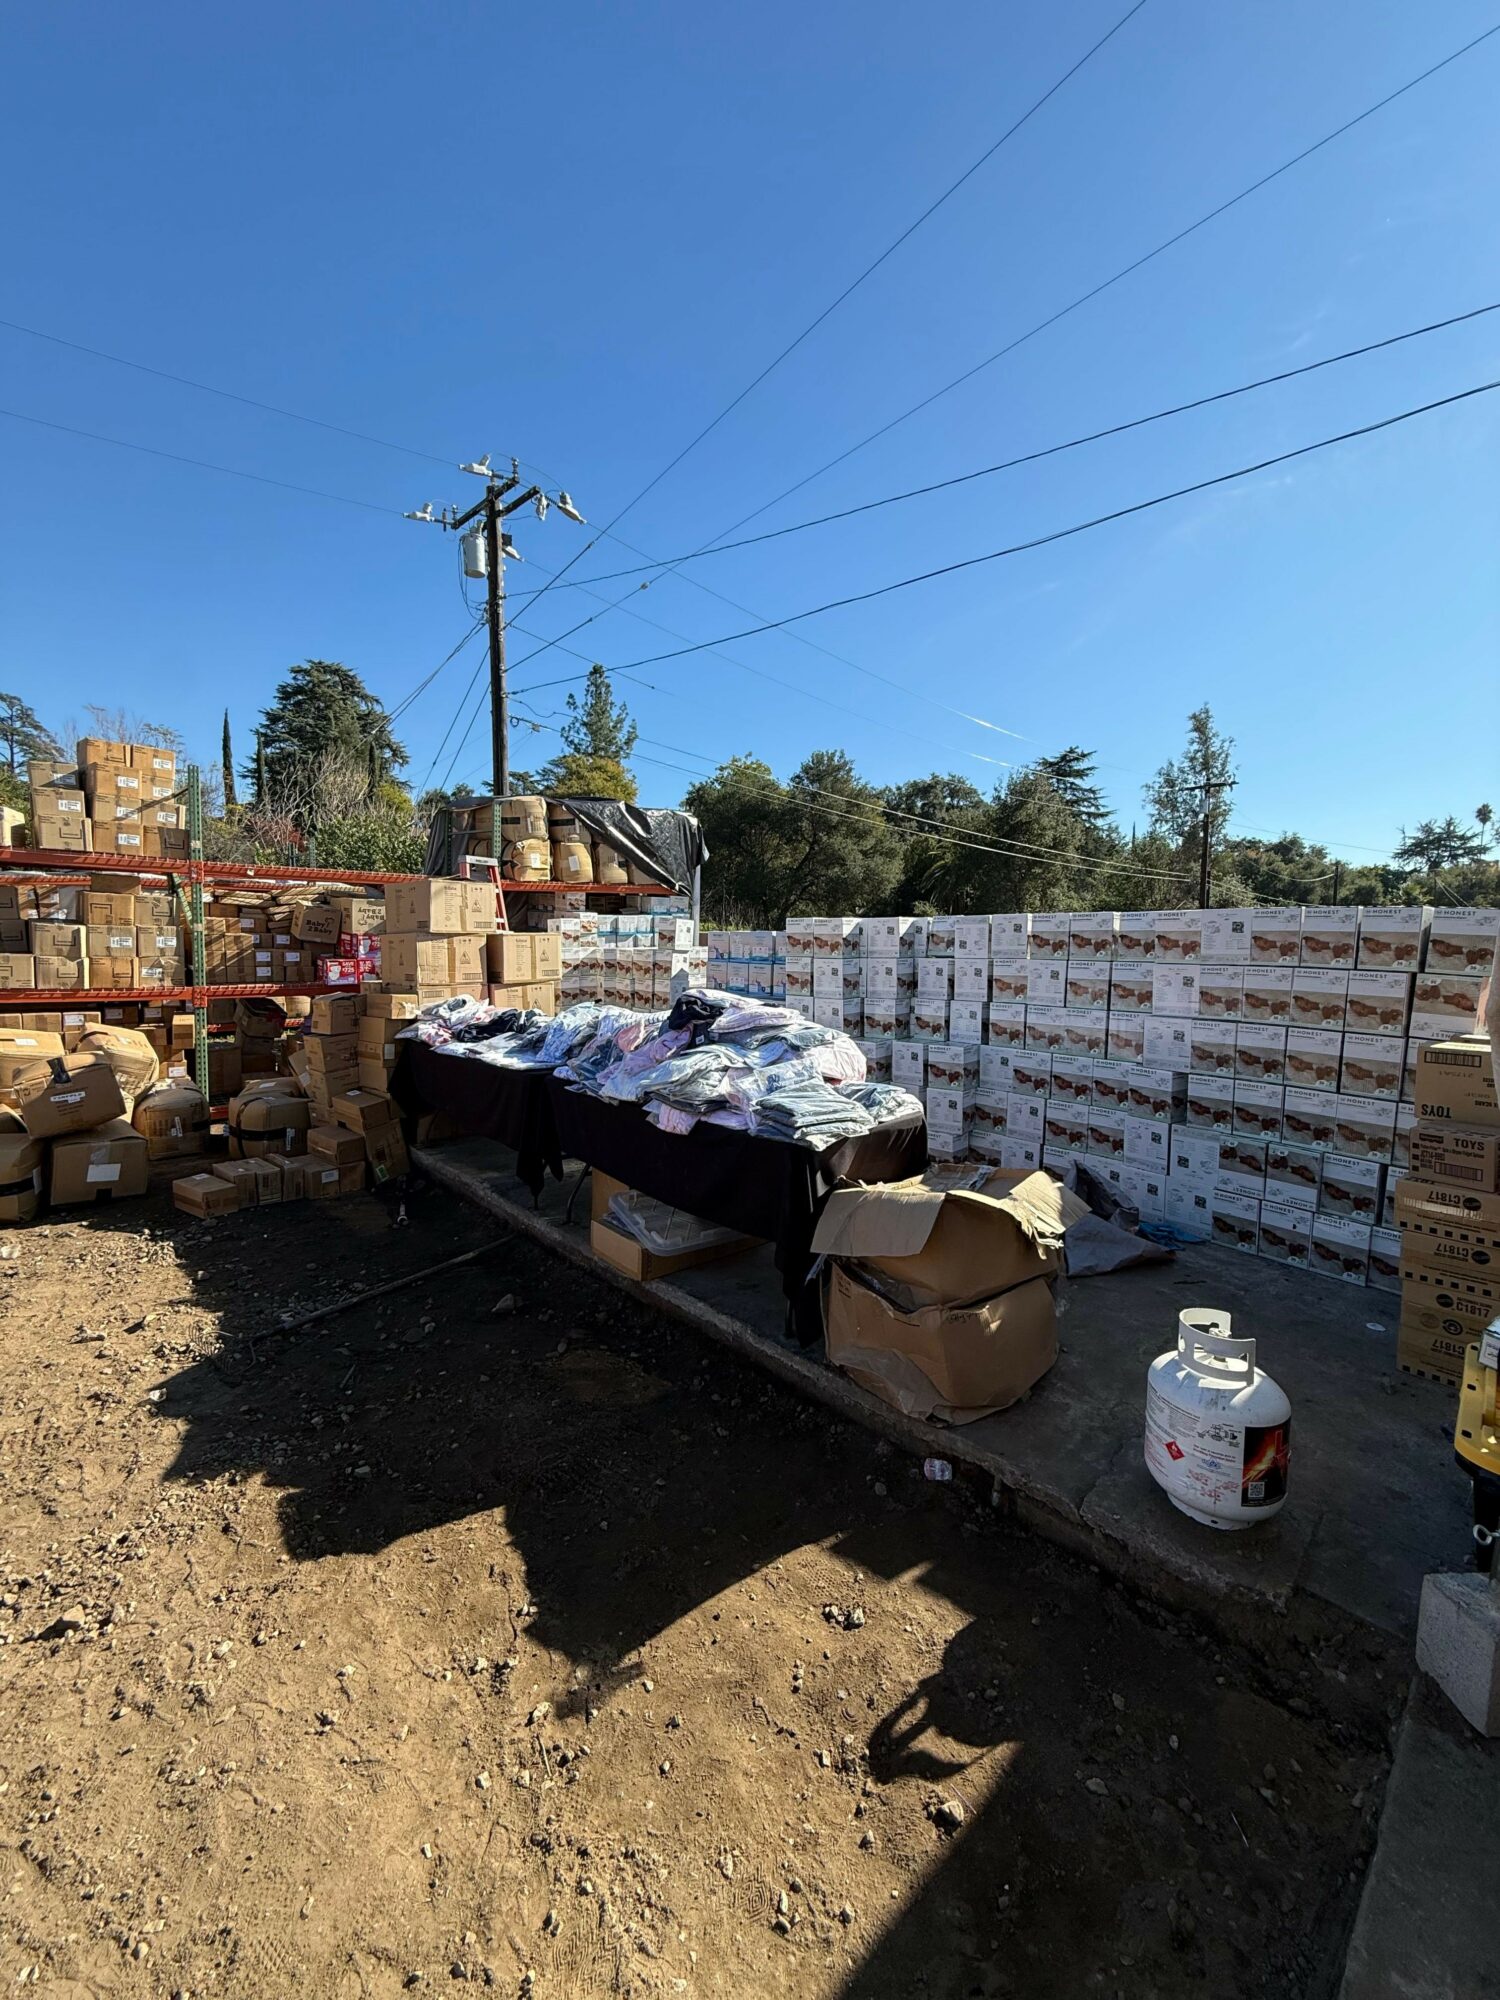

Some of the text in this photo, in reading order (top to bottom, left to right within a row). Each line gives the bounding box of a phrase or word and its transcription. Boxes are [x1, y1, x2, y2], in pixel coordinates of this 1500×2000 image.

[306, 919, 325, 928] Baby
[1294, 1090, 1320, 1098] HONEST
[1347, 1098, 1375, 1106] HONEST
[1096, 1107, 1116, 1115] HONEST
[1421, 1104, 1451, 1119] TOYS
[1454, 1138, 1484, 1151] TOYS
[1333, 1157, 1360, 1166] HONEST
[1233, 1188, 1256, 1196] HONEST
[1219, 1194, 1242, 1202] HONEST
[1428, 1190, 1461, 1204] C1817
[1282, 1199, 1308, 1207] HONEST
[1269, 1205, 1295, 1214] HONEST
[1322, 1217, 1350, 1227] HONEST
[1436, 1243, 1469, 1257] C1817
[1456, 1301, 1490, 1318] C1817
[1432, 1339, 1465, 1355] C1817
